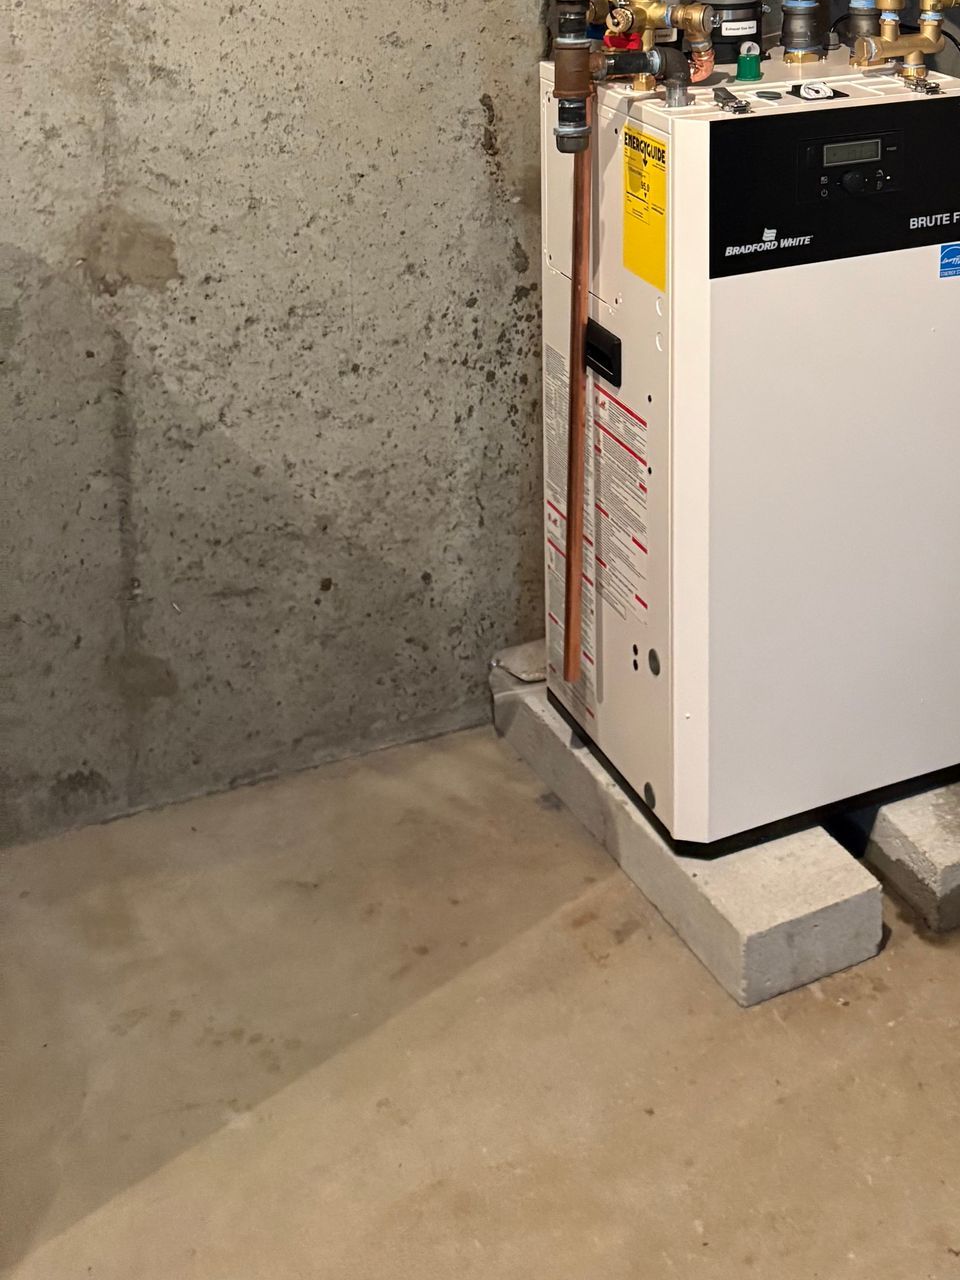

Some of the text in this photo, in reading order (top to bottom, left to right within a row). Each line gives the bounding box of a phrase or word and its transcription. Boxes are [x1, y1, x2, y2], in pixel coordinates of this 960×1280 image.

[909, 213, 950, 229] BRUTE
[725, 236, 811, 256] BRADFORD WHITE
